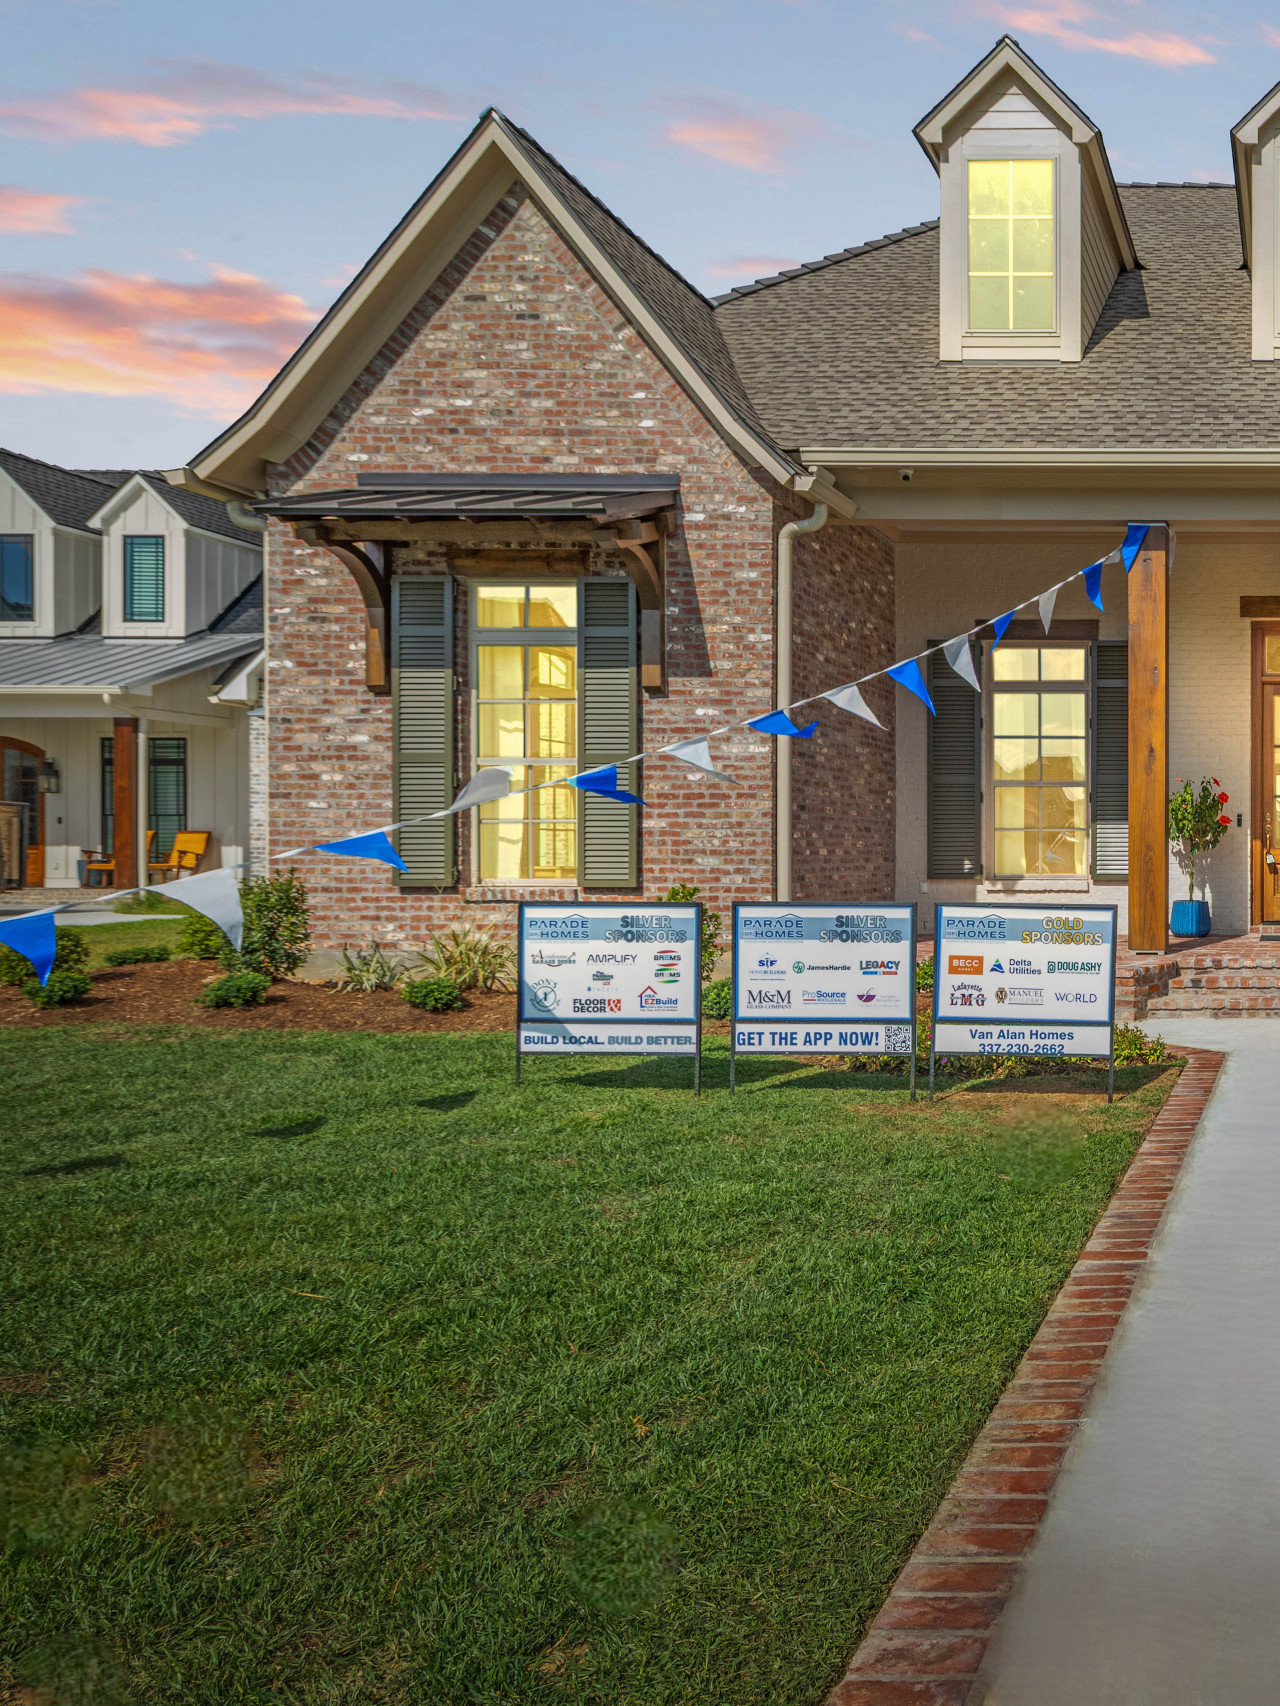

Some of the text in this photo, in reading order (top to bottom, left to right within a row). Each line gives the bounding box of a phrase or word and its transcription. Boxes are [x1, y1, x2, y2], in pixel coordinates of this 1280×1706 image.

[529, 920, 589, 928] PARADE
[620, 915, 671, 928] SILVER
[743, 920, 804, 928] PARADE
[835, 915, 886, 928] SILVER
[946, 920, 1006, 928] PARADE
[1042, 917, 1083, 930] GOLD
[540, 931, 589, 939] HOMES
[604, 930, 687, 943] SPONSORS
[819, 930, 902, 943] SPONSORS
[957, 930, 1006, 938] HOMES
[1021, 931, 1103, 945] SPONSORS
[587, 954, 637, 963] AMPLIFY
[953, 959, 979, 967] BECC
[1009, 958, 1032, 966] Delta
[859, 960, 901, 970] LEGACY
[1057, 961, 1102, 972] DOUG ASHY
[1009, 967, 1042, 975] Utilities
[531, 978, 558, 990] DON'S
[952, 982, 982, 992] Lafayette
[747, 989, 792, 1004] M&M
[802, 990, 846, 998] ProSource
[1055, 992, 1097, 1003] WORLD
[737, 1032, 879, 1046] GET THE APP NOW!
[969, 1029, 1074, 1040] Van Alan Homes
[524, 1036, 695, 1046] BUILD LOCAL. BUILD BETTER.
[979, 1044, 1065, 1055] 337-230-2662
